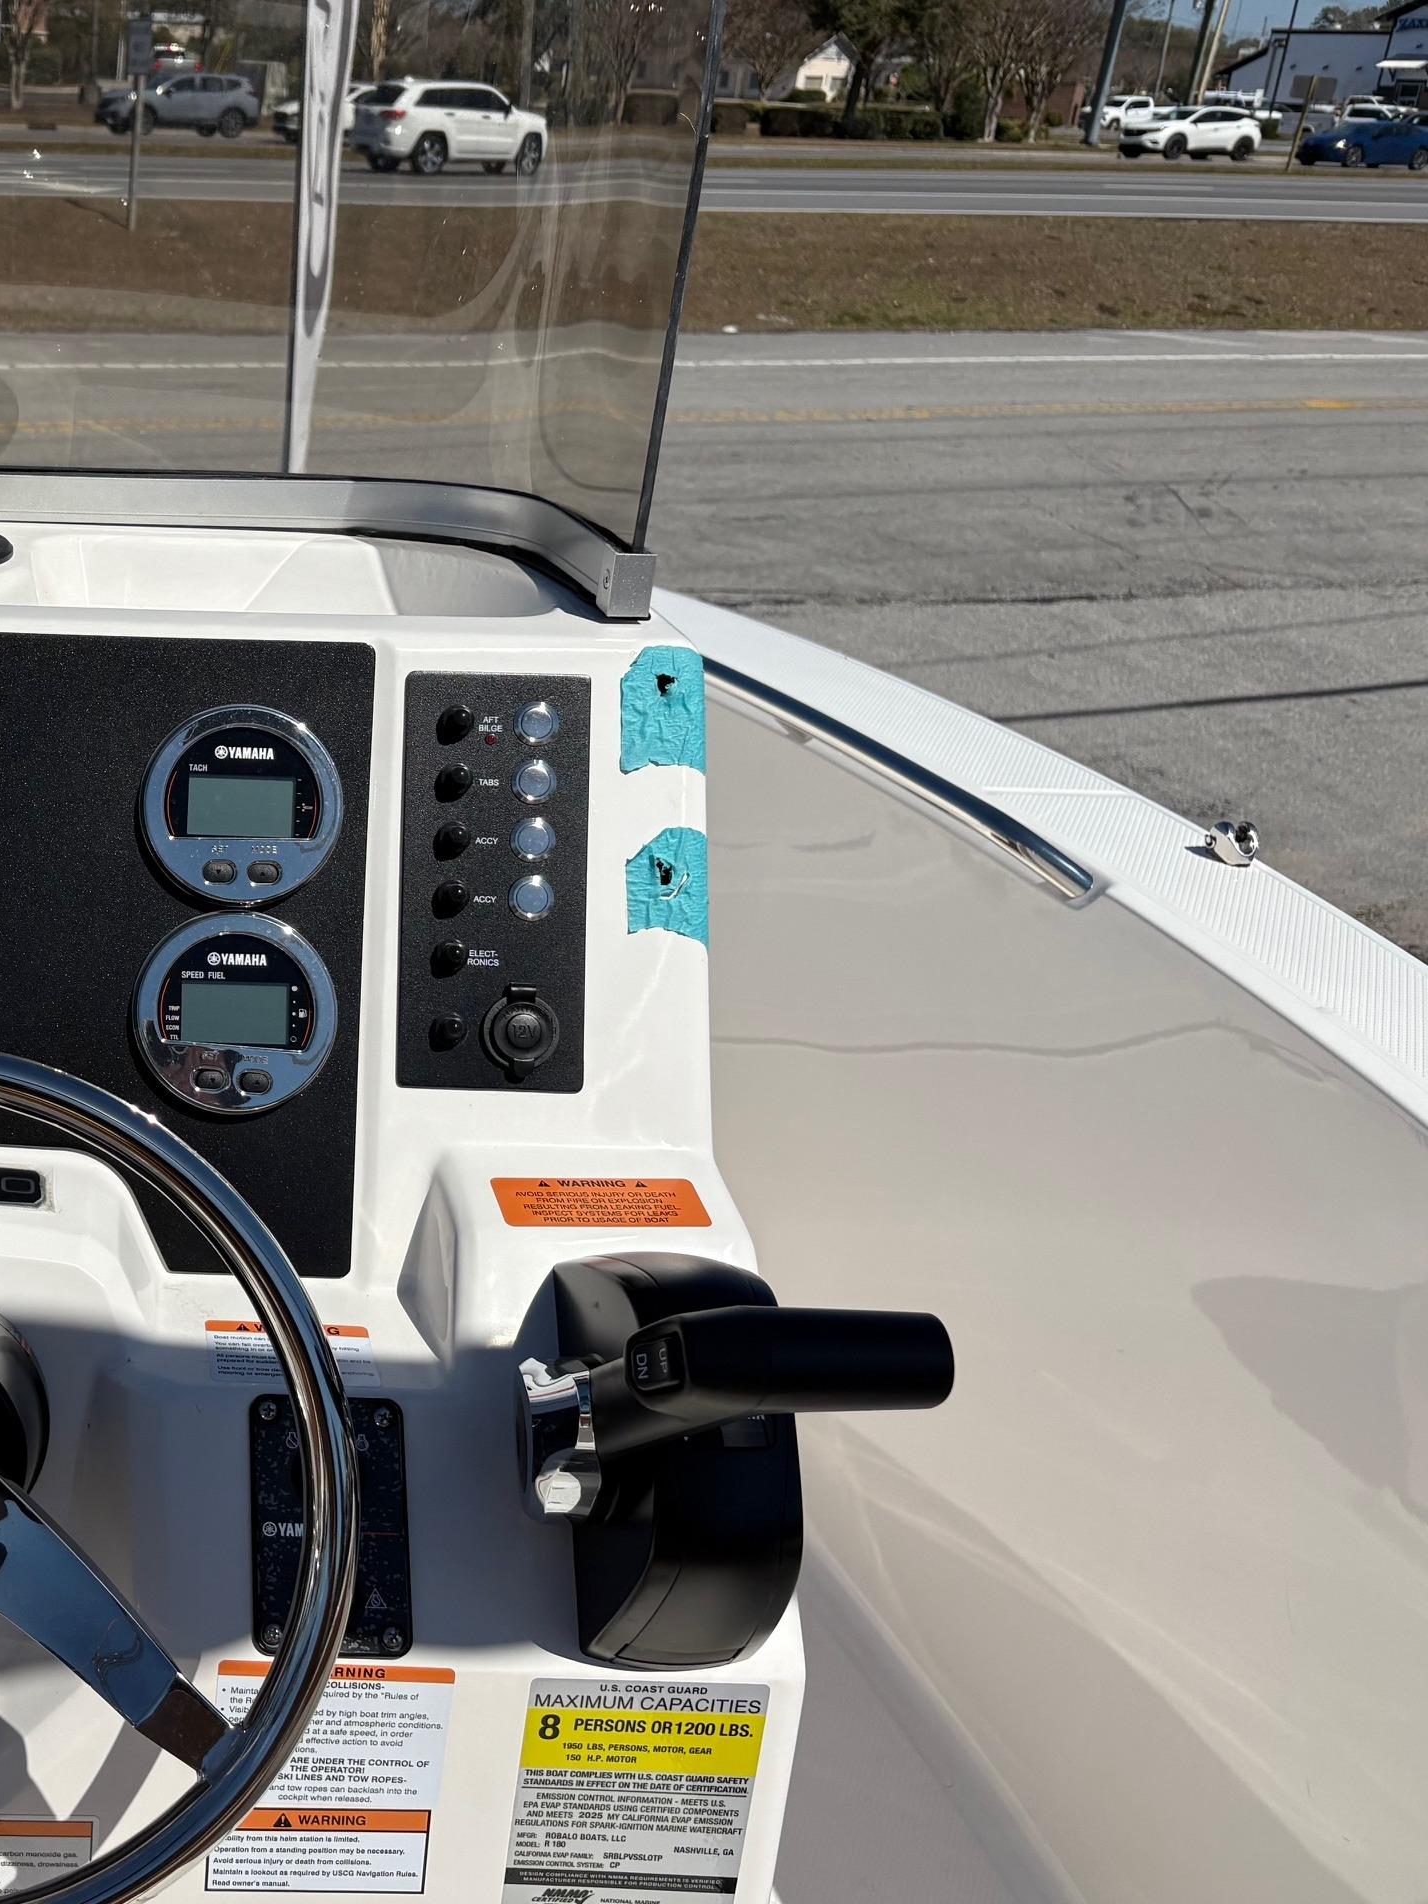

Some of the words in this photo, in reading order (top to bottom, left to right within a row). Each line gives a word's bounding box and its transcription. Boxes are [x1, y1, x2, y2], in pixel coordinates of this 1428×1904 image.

[483, 716, 499, 724] AFT
[478, 724, 503, 732] BILGE
[228, 747, 275, 760] YAMAHA
[189, 764, 208, 772] TACH
[475, 837, 498, 845] ACCY
[220, 953, 267, 966] YAMAHA
[467, 958, 500, 967] RONICS
[512, 1025, 538, 1038] 12V
[636, 1353, 648, 1379] DN
[278, 1522, 304, 1537] YAM
[332, 1666, 386, 1678] RNING
[599, 1684, 620, 1692] U.S.
[625, 1685, 662, 1693] COAST
[667, 1686, 707, 1694] GUARD
[534, 1693, 633, 1709] MAXIMUM
[640, 1696, 760, 1713] CAPACITIES
[538, 1714, 560, 1739] 8
[573, 1718, 646, 1733] PERSONS
[650, 1720, 672, 1734] OR
[676, 1721, 715, 1735] 1200
[719, 1723, 753, 1737] LBS.
[607, 1744, 649, 1752] PERSONS,
[652, 1745, 685, 1753] MOTOR,
[368, 1758, 413, 1767] CONTROL
[290, 1764, 308, 1772] THE
[310, 1765, 364, 1773] OPERATOR!
[371, 1775, 406, 1783] ROPES-
[569, 1770, 612, 1778] COMPLIES
[716, 1776, 748, 1784] SAFETY
[298, 1814, 365, 1825] WARNING
[545, 1832, 577, 1842] ROBALO
[579, 1833, 608, 1841] BOATS,
[610, 1834, 626, 1842] LLC
[673, 1846, 719, 1854] NASHVILLE,
